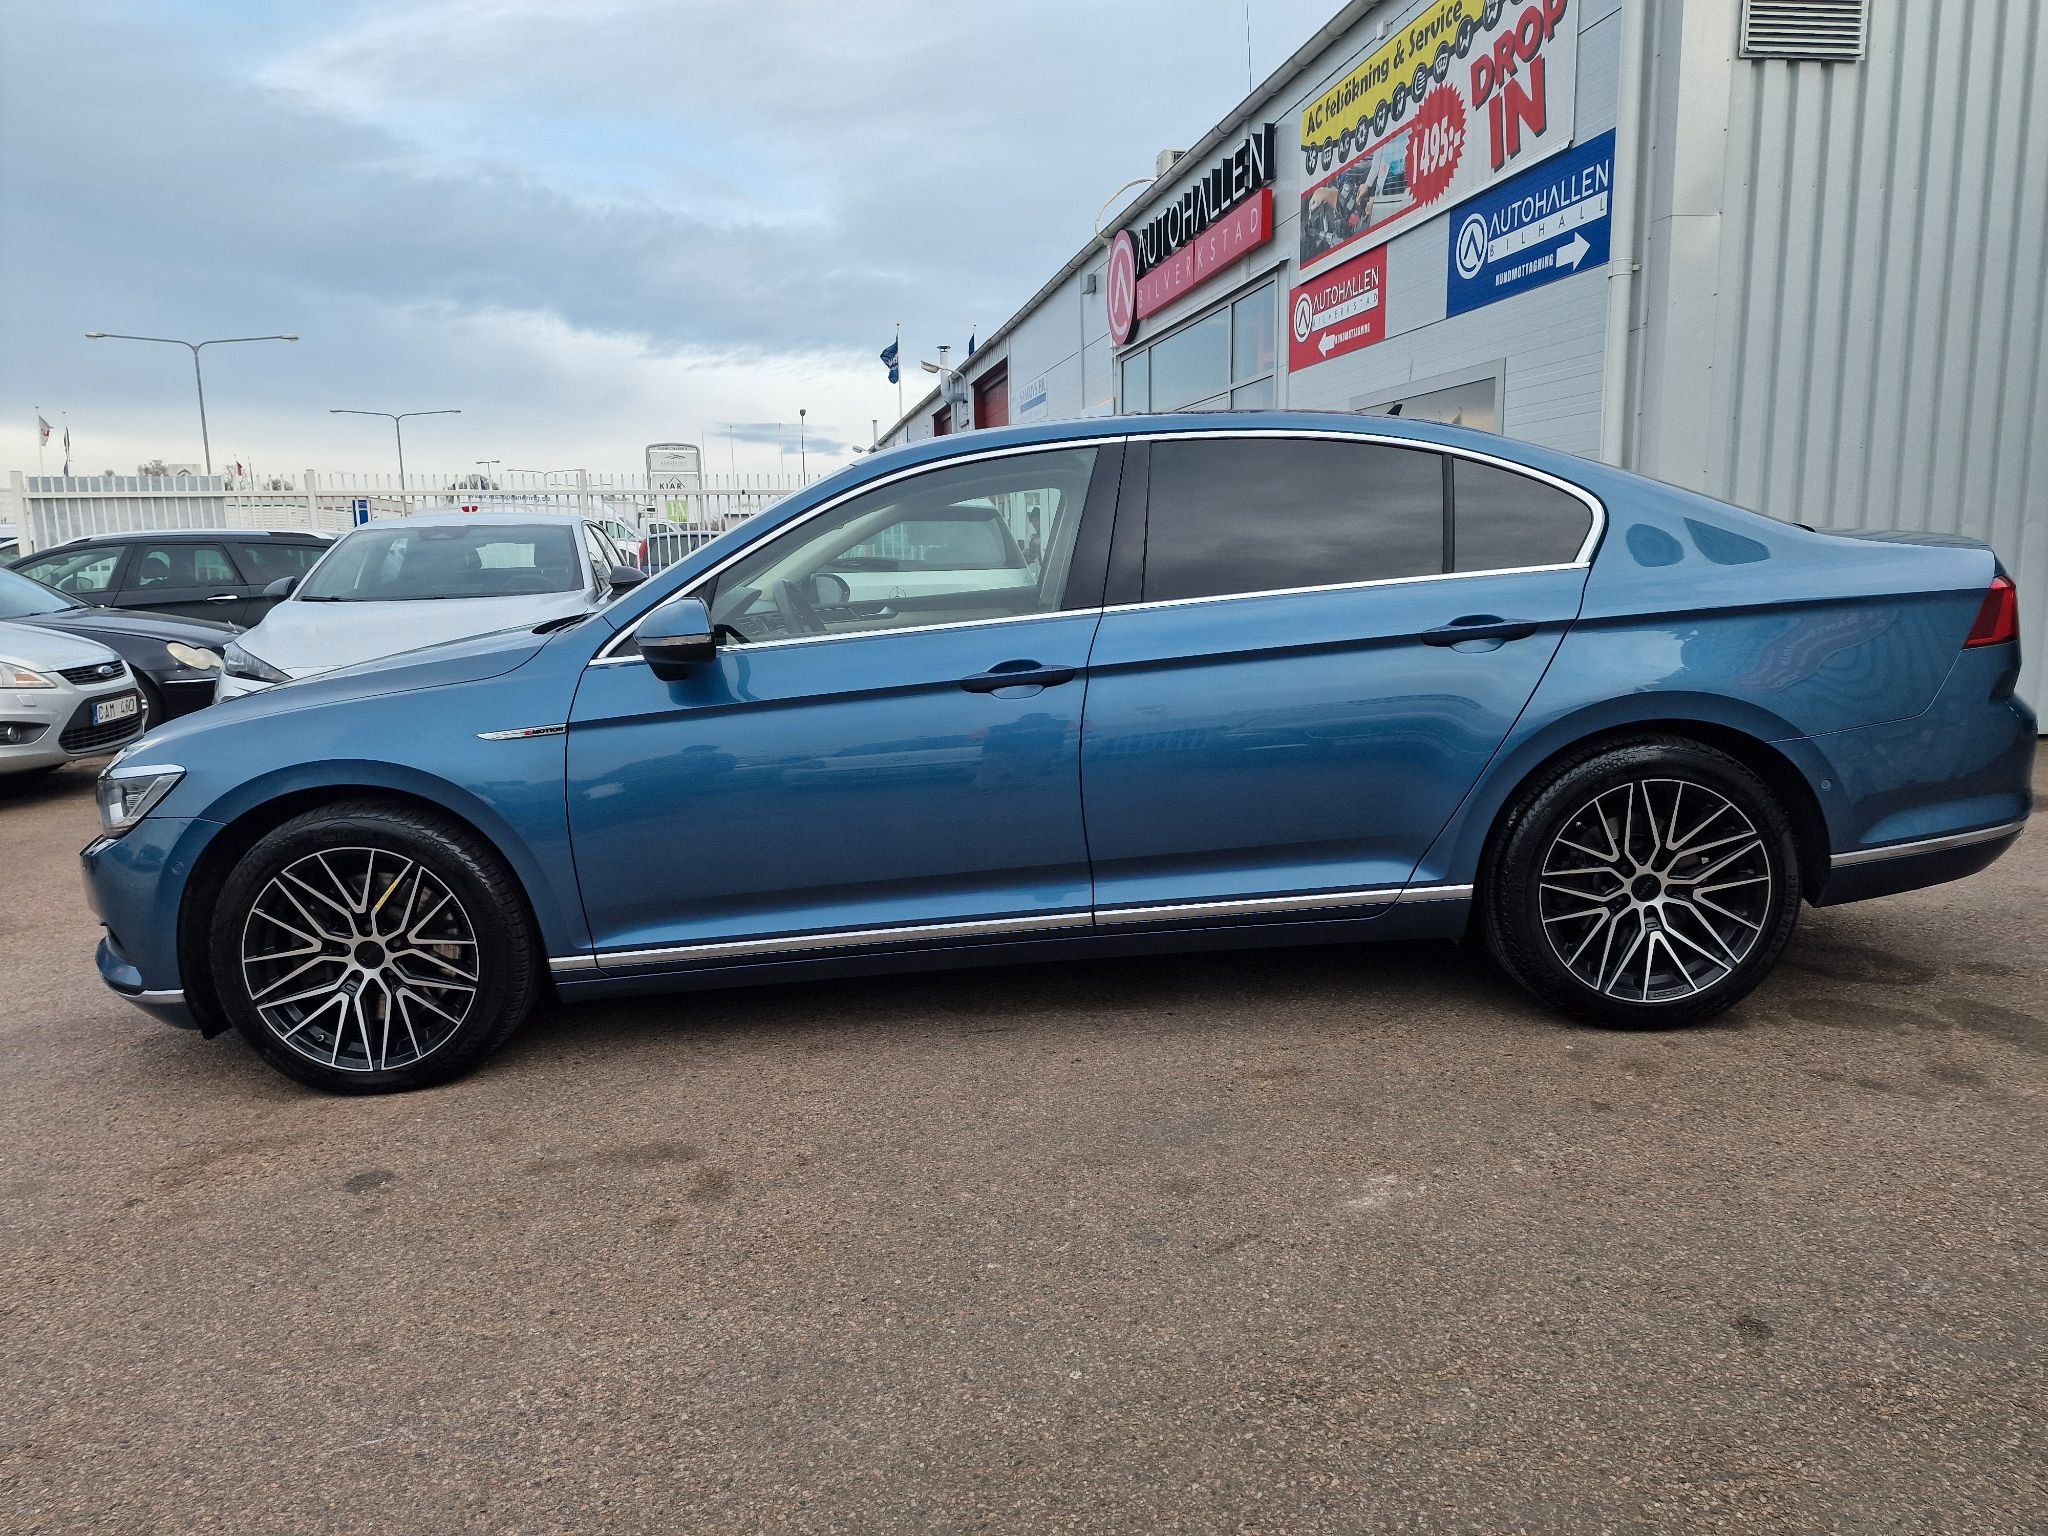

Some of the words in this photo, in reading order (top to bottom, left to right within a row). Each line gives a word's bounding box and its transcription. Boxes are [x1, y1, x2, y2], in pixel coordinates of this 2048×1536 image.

[1306, 103, 1323, 137] AC
[1325, 56, 1390, 122] felsökning
[1393, 39, 1405, 70] &
[1408, 0, 1463, 58] Service
[1470, 0, 1568, 111] DROP
[1489, 53, 1547, 173] IN
[1136, 122, 1274, 275] AUTOHALLEN
[1488, 159, 1609, 238] AUTOHALLEN
[1489, 197, 1605, 257] BILHALL
[1138, 207, 1259, 309] BILVERKSTAD
[1312, 265, 1379, 312] AUTOHALLEN
[1495, 253, 1554, 287] KUNDMOTTAGNING
[1313, 293, 1377, 327] BILVERKSTAD
[98, 703, 115, 720] CAM
